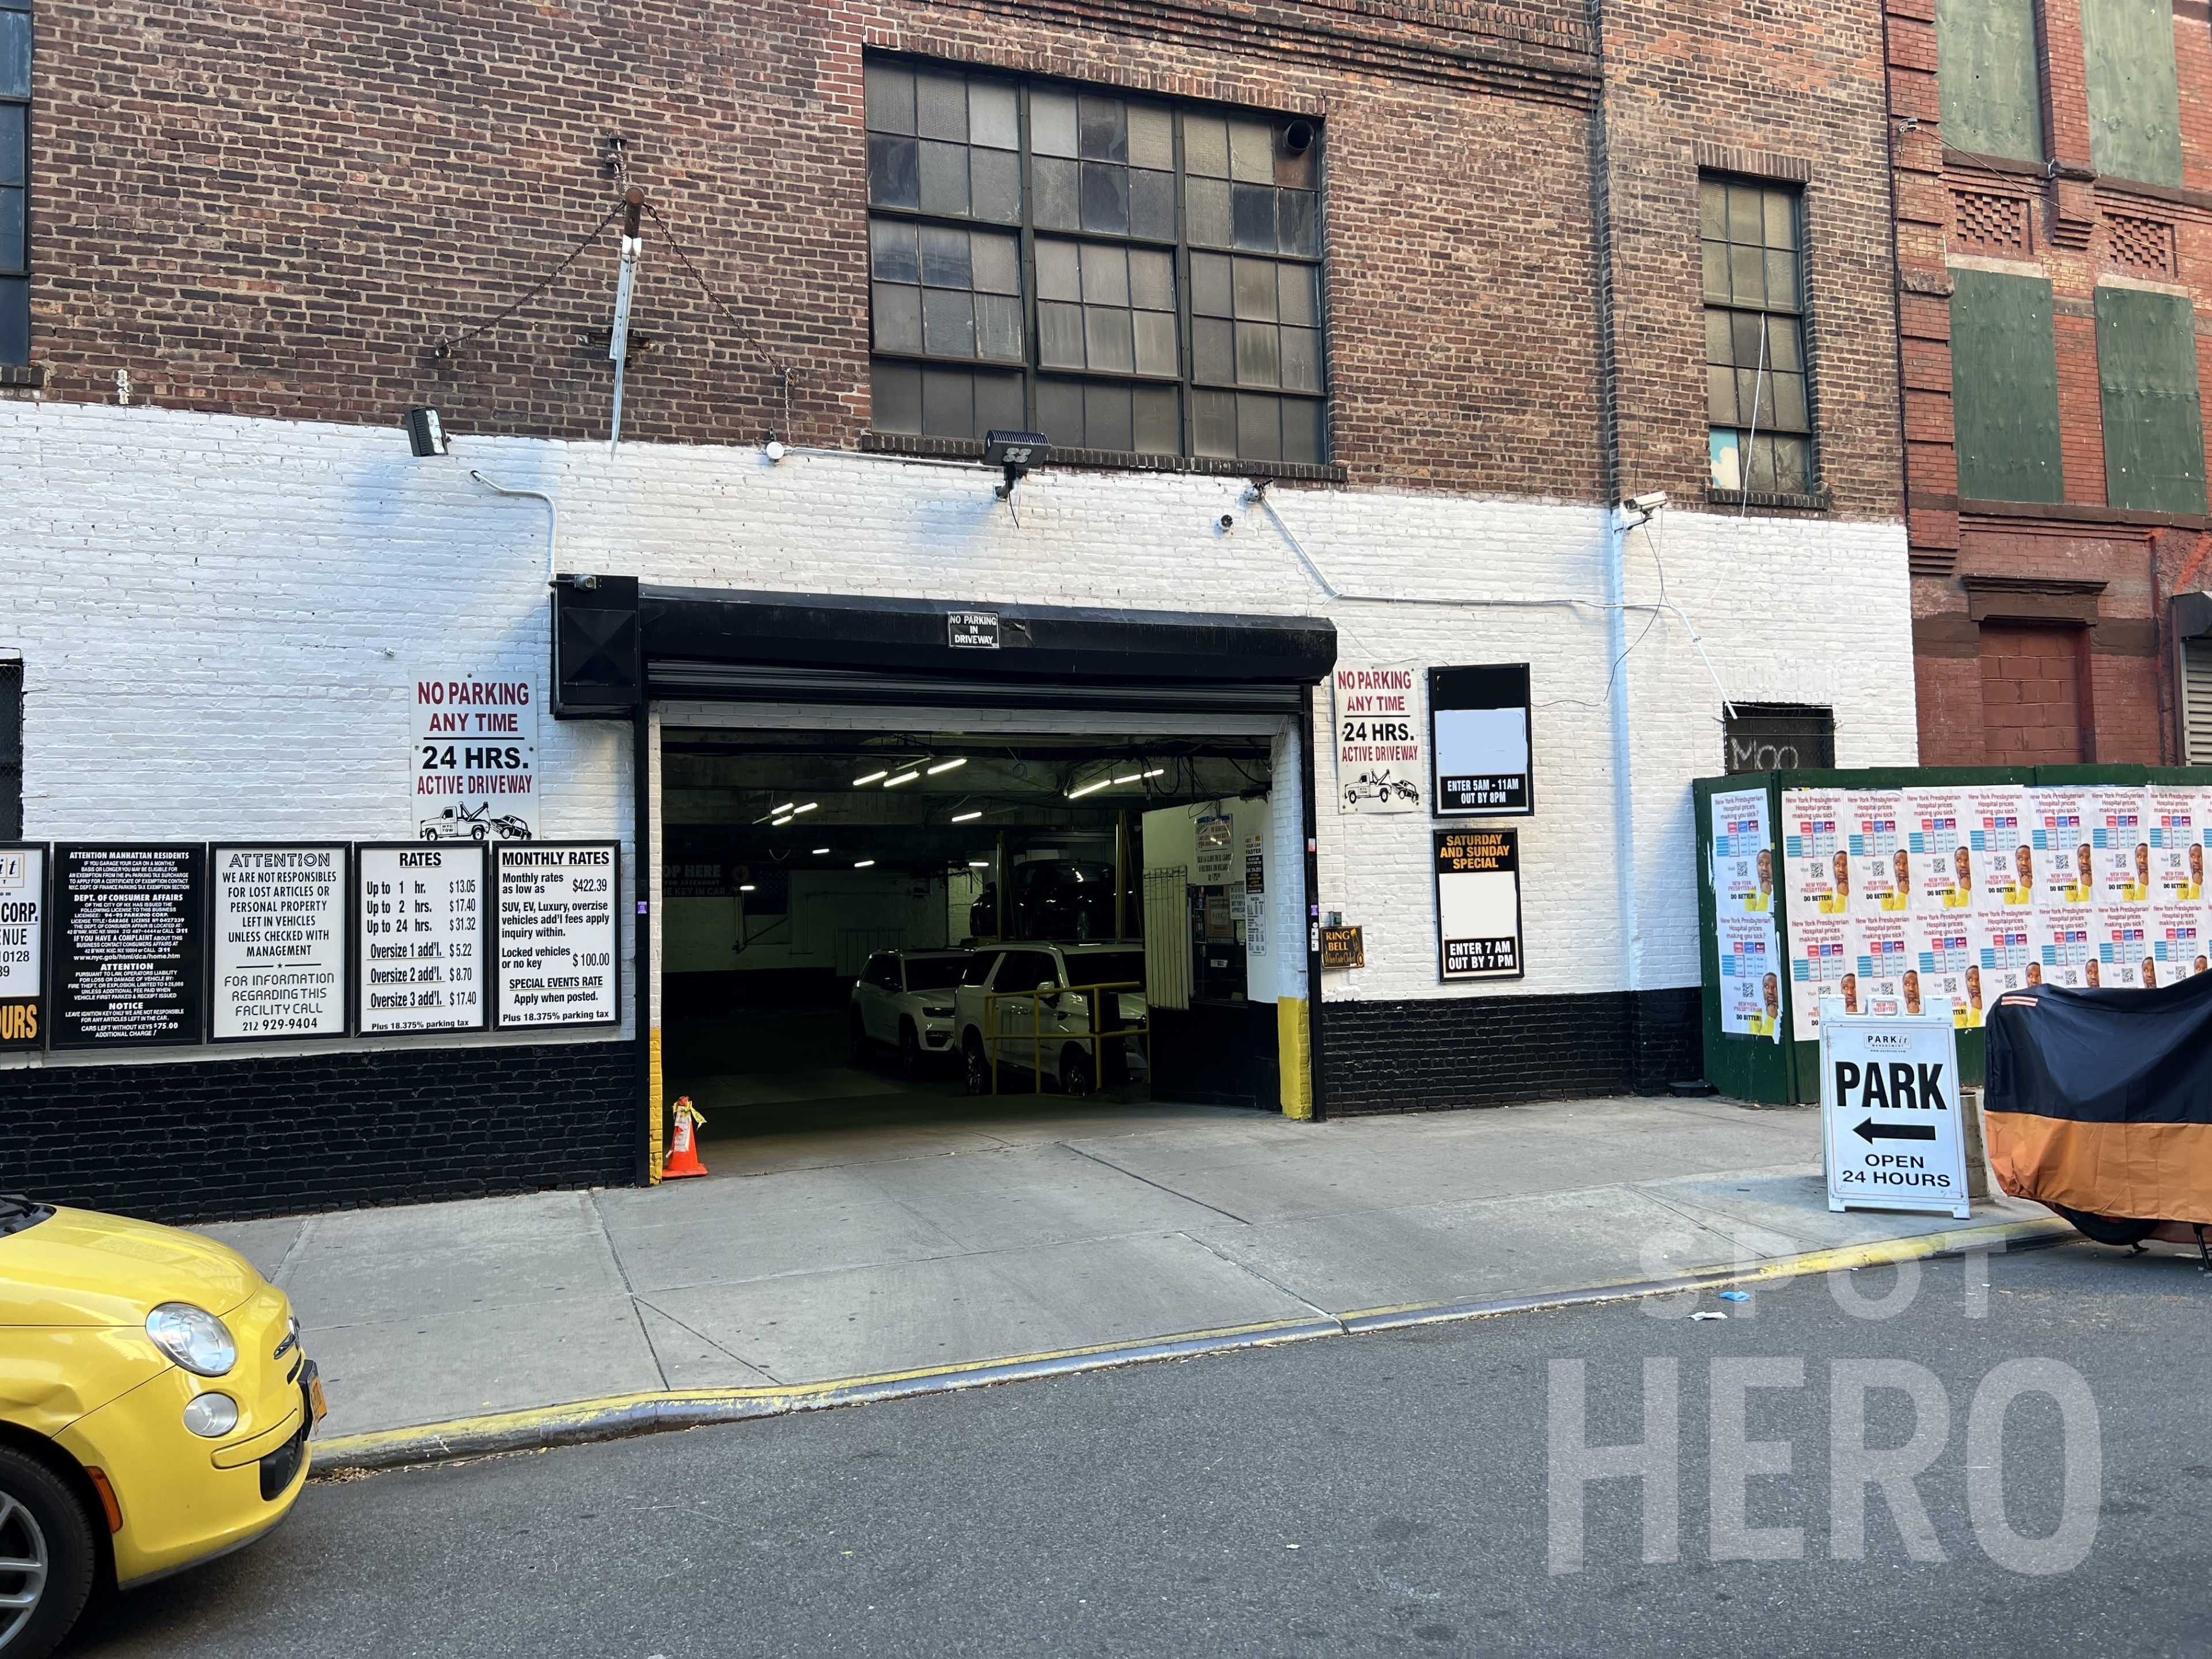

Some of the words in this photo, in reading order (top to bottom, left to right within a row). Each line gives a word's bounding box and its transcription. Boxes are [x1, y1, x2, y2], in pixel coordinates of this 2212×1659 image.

[950, 616, 961, 624] NO
[964, 616, 997, 625] PARKING
[970, 626, 978, 634] IN
[955, 635, 993, 645] DRIVEWAY
[1338, 671, 1355, 689] NO
[1358, 671, 1411, 689] PARKING
[418, 681, 444, 704] NO
[449, 682, 529, 705] PARKING
[1347, 696, 1372, 711] ANY
[1376, 696, 1405, 711] TIME
[429, 713, 469, 732] ANY
[475, 713, 518, 732] TIME
[1344, 722, 1366, 741] 24
[1372, 723, 1414, 741] HRS.
[422, 745, 456, 769] 24
[465, 747, 528, 769] HRS.
[1342, 747, 1372, 762] ACTIVE
[1376, 745, 1418, 761] DRIVEWAY
[418, 775, 463, 794] ACTIVE
[468, 775, 532, 794] DRIVEWAY
[1448, 781, 1471, 791] ENTER
[1474, 779, 1489, 790] 5AM
[1498, 779, 1518, 790] 11AM
[1461, 793, 1475, 804] OUT
[1478, 792, 1487, 803] BY
[1490, 791, 1506, 803] 8PM
[1446, 834, 1502, 846] SATURDAY
[502, 852, 565, 865] MONTHLY
[569, 851, 609, 865] RATES
[1441, 847, 1463, 858] AND
[1467, 846, 1510, 857] SUNDAY
[229, 853, 330, 868] ATTENTION
[400, 852, 442, 866] RATES
[1453, 858, 1498, 869] SPECIAL
[223, 872, 236, 883] WE
[238, 872, 255, 882] ARE
[258, 872, 275, 883] NOT
[277, 871, 336, 882] RESPONSIBLES
[684, 865, 721, 878] HERE
[502, 873, 539, 884] Monthly
[541, 873, 564, 882] rates
[228, 888, 245, 898] FOR
[249, 887, 271, 897] LOST
[274, 886, 313, 897] ARTICLES
[317, 886, 329, 896] OR
[367, 881, 379, 896] Up
[381, 882, 391, 894] to
[399, 881, 404, 893] 1
[415, 881, 426, 893] hr.
[502, 885, 513, 894] as
[516, 884, 532, 894] low
[535, 885, 545, 893] as
[573, 878, 607, 893] $422.39
[1, 902, 38, 923] CORP.
[230, 902, 277, 912] PERSONAL
[281, 901, 327, 912] PROPERTY
[502, 902, 521, 913] SUV,
[524, 902, 536, 912] EV,
[538, 901, 570, 914] Luxury,
[572, 902, 608, 911] overzise
[243, 917, 261, 927] LEFT
[264, 916, 273, 927] IN
[275, 915, 316, 926] VEHICLES
[502, 914, 538, 925] vehicles
[565, 914, 583, 923] fees
[586, 914, 609, 925] apply
[367, 920, 379, 935] Up
[381, 920, 391, 933] to
[396, 919, 407, 933] 24
[415, 919, 432, 932] hrs.
[229, 931, 260, 942] UNLESS
[264, 931, 303, 942] CHECKED
[306, 930, 329, 941] WITH
[1326, 931, 1350, 940] RING
[247, 945, 312, 957] MANAGEMENT
[370, 944, 407, 959] Oversize
[410, 944, 414, 957] 1
[1328, 942, 1349, 951] BELL
[1450, 942, 1482, 955] ENTER
[1486, 942, 1491, 953] 7
[1495, 941, 1510, 953] AM
[1448, 957, 1468, 969] OUT
[1472, 956, 1484, 968] BY
[1488, 956, 1494, 967] 7
[1498, 955, 1513, 967] PM
[225, 976, 248, 987] FOR
[252, 973, 334, 986] INFORMATION
[509, 978, 545, 989] SPECIAL
[547, 977, 579, 988] EVENTS
[582, 976, 603, 987] RATE
[232, 990, 298, 1001] REGARDING
[301, 988, 327, 998] THIS
[236, 1005, 290, 1016] FACILITY
[293, 1003, 323, 1014] CALL
[0, 1004, 37, 1039] URS
[243, 1021, 259, 1031] 212
[263, 1018, 317, 1030] 929-9404
[1835, 1061, 1948, 1110] PARK
[1865, 1154, 1924, 1168] OPEN
[1843, 1171, 1866, 1183] 24
[1873, 1171, 1950, 1187] HOURS
